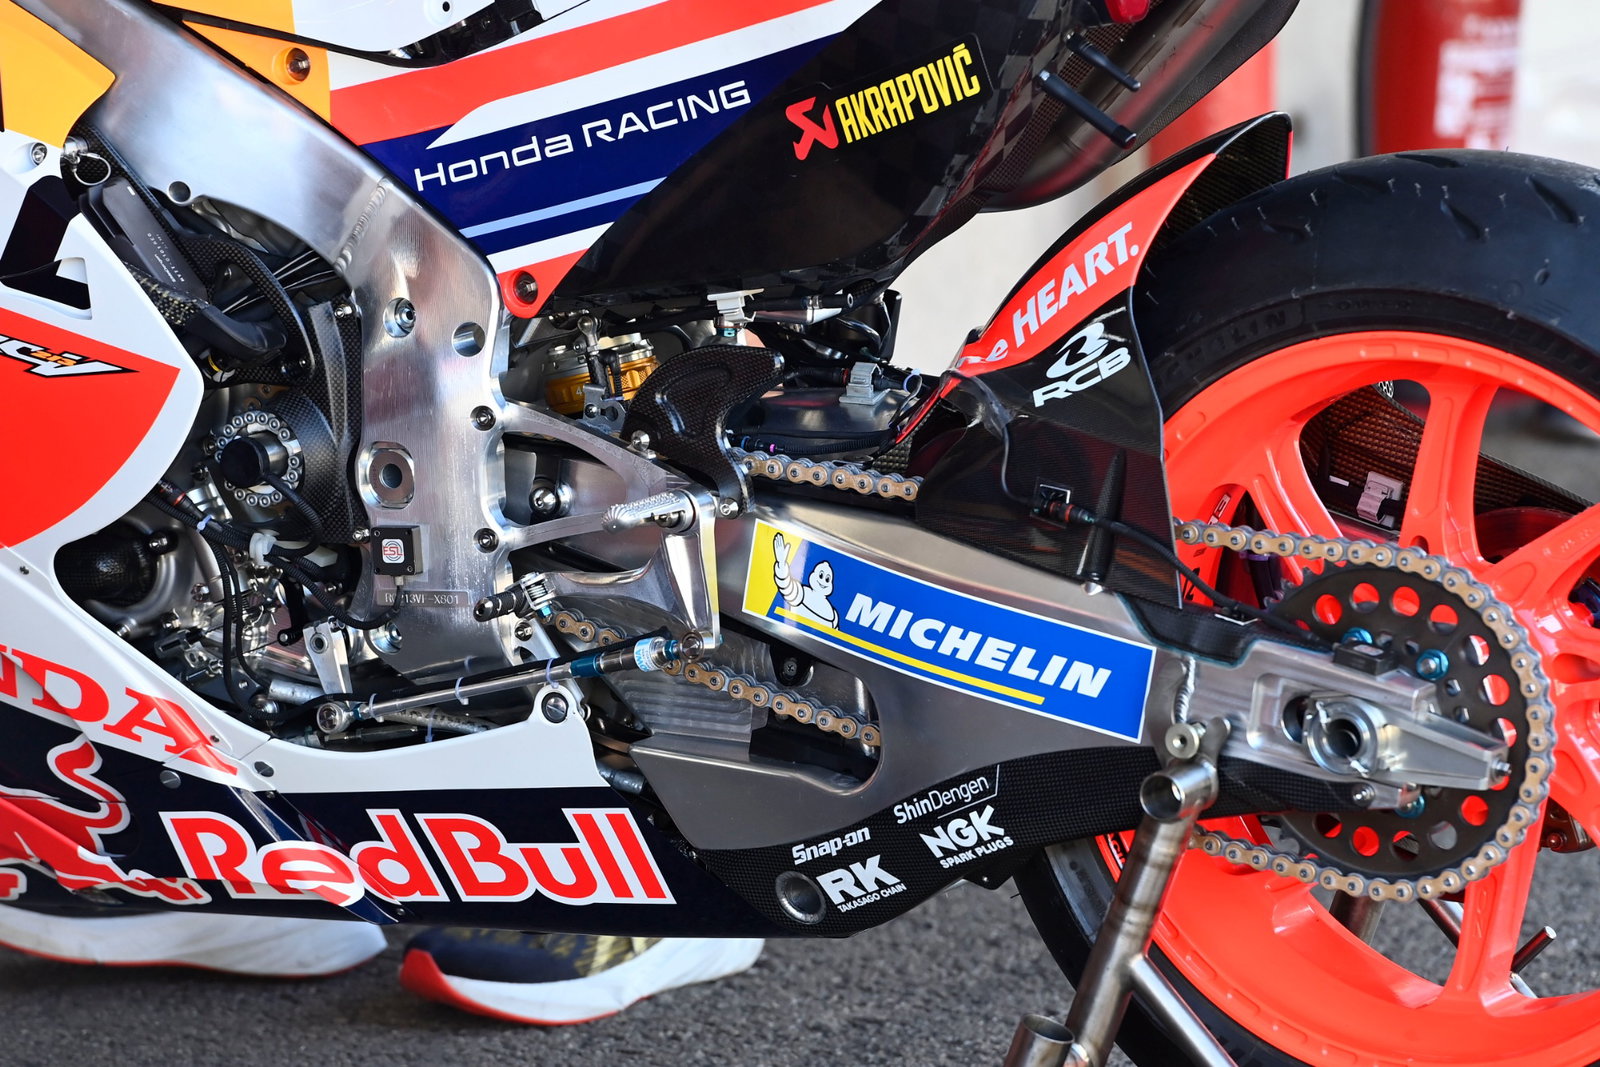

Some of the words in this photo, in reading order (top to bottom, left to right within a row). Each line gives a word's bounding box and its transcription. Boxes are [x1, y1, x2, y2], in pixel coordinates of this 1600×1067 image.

[836, 43, 981, 144] AKRAPOVIČ
[414, 135, 574, 191] Honda
[581, 80, 752, 149] RACING
[1011, 222, 1140, 349] HEART.
[1032, 346, 1132, 408] RCB
[383, 546, 403, 557] ESL
[844, 592, 1113, 699] MICHELIN
[893, 776, 990, 825] ShinDengen
[159, 809, 450, 906] Red
[414, 807, 678, 906] Bull
[791, 826, 872, 866] Snap-on
[919, 804, 1005, 859] NGK
[939, 850, 977, 870] SPARK
[975, 836, 1014, 858] PLUGS
[815, 854, 901, 906] RK
[836, 893, 881, 914] TAKASAGO
[879, 882, 908, 899] CHAIN
